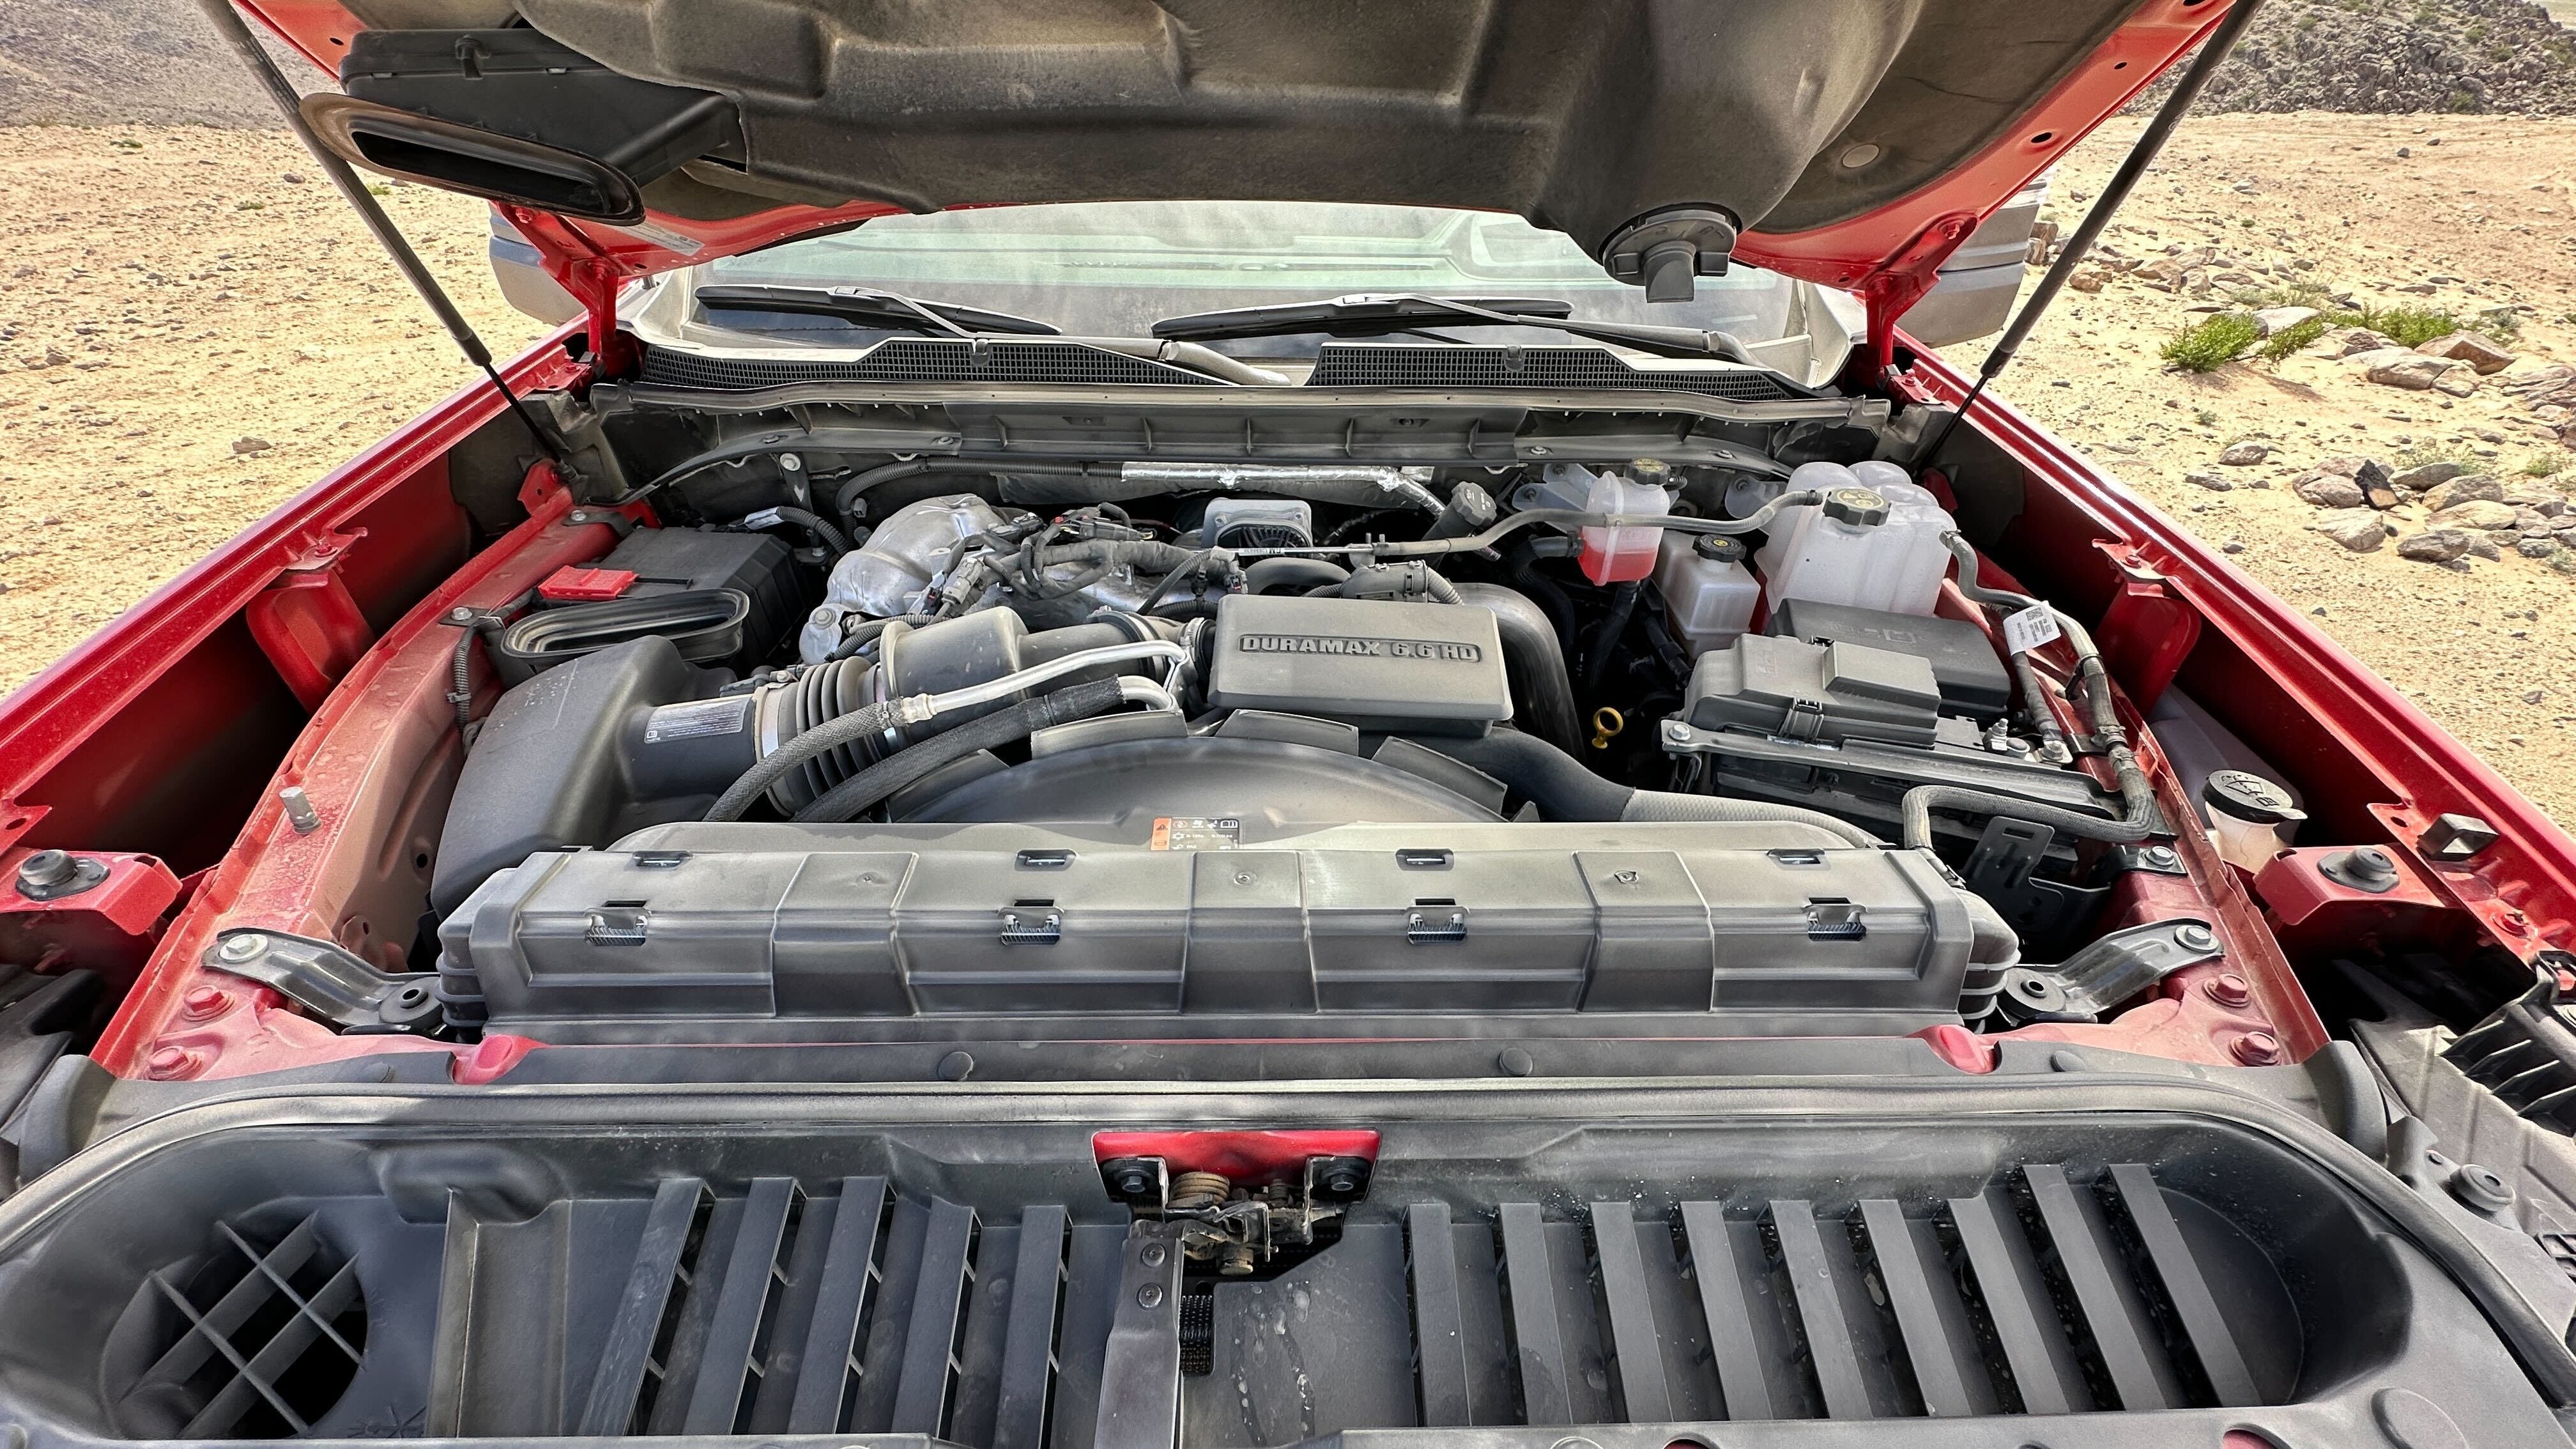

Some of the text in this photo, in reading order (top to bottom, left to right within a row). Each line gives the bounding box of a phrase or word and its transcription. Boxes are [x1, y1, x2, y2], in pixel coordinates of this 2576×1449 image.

[1242, 637, 1481, 662] DURAMAX 6.6 HD
